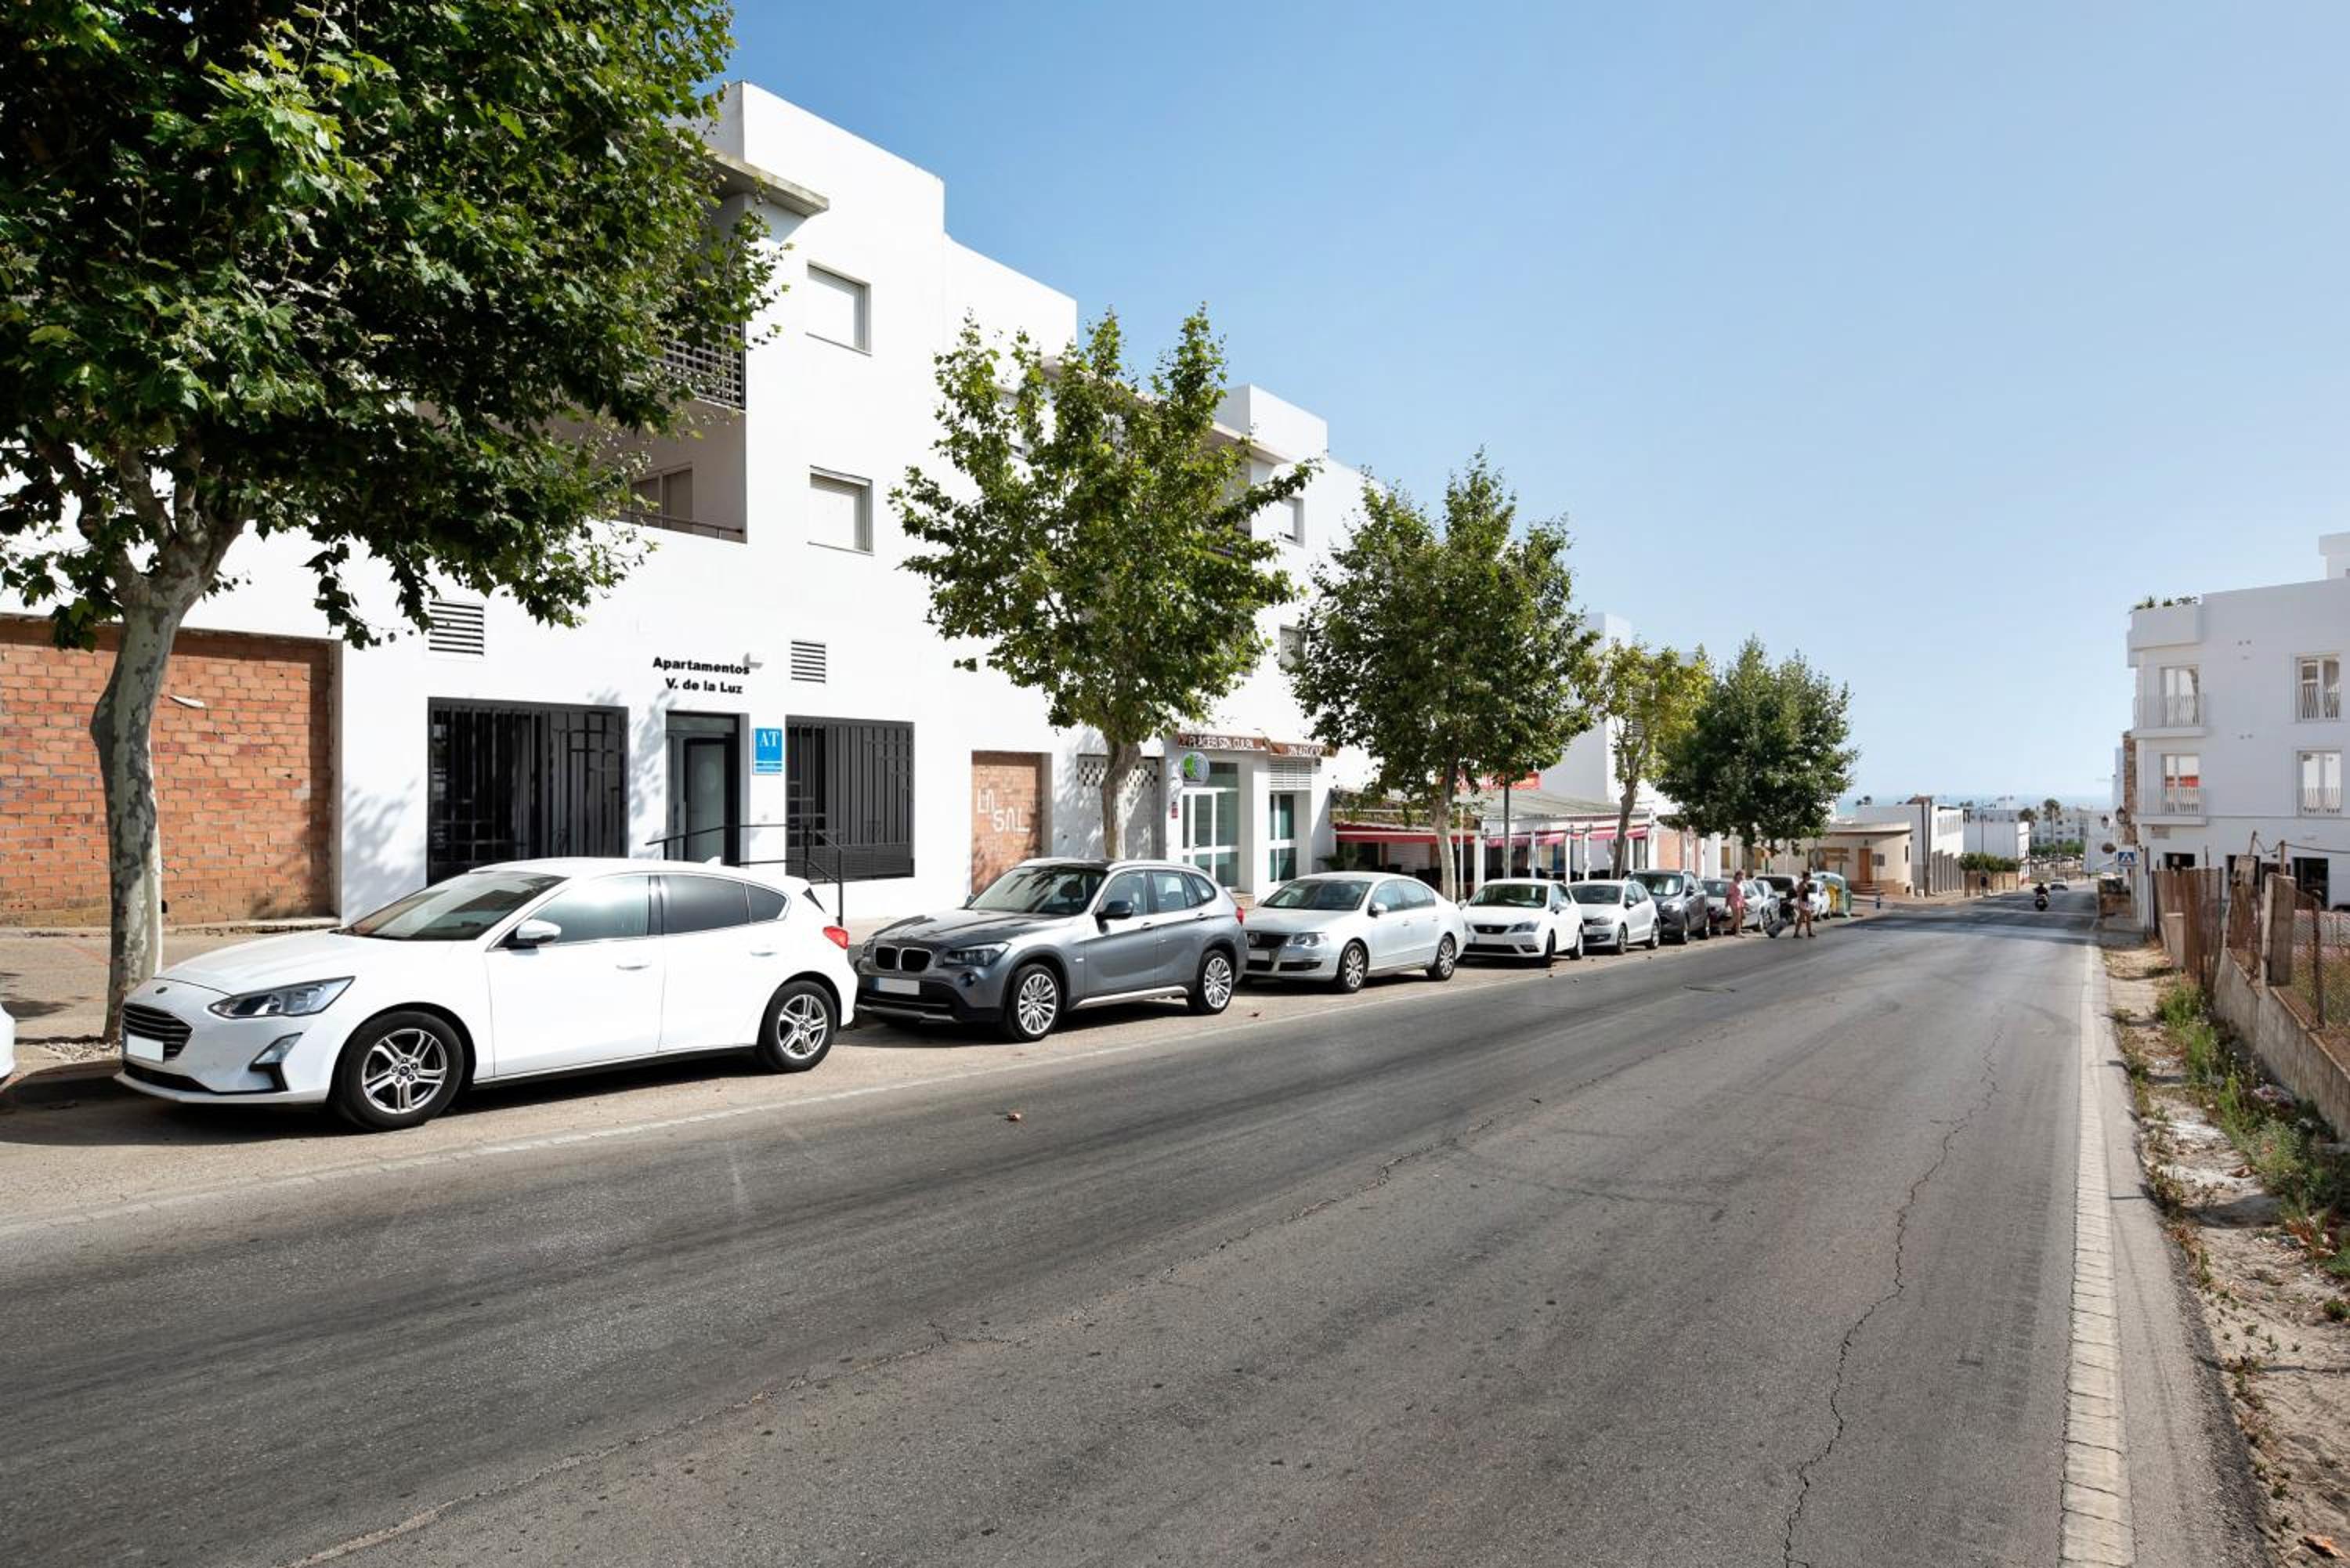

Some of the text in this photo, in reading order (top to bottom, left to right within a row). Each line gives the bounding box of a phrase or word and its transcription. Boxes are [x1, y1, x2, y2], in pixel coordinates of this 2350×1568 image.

[653, 656, 750, 674] Apartamentos
[665, 677, 743, 694] V. de la Luz
[760, 731, 779, 746] AT
